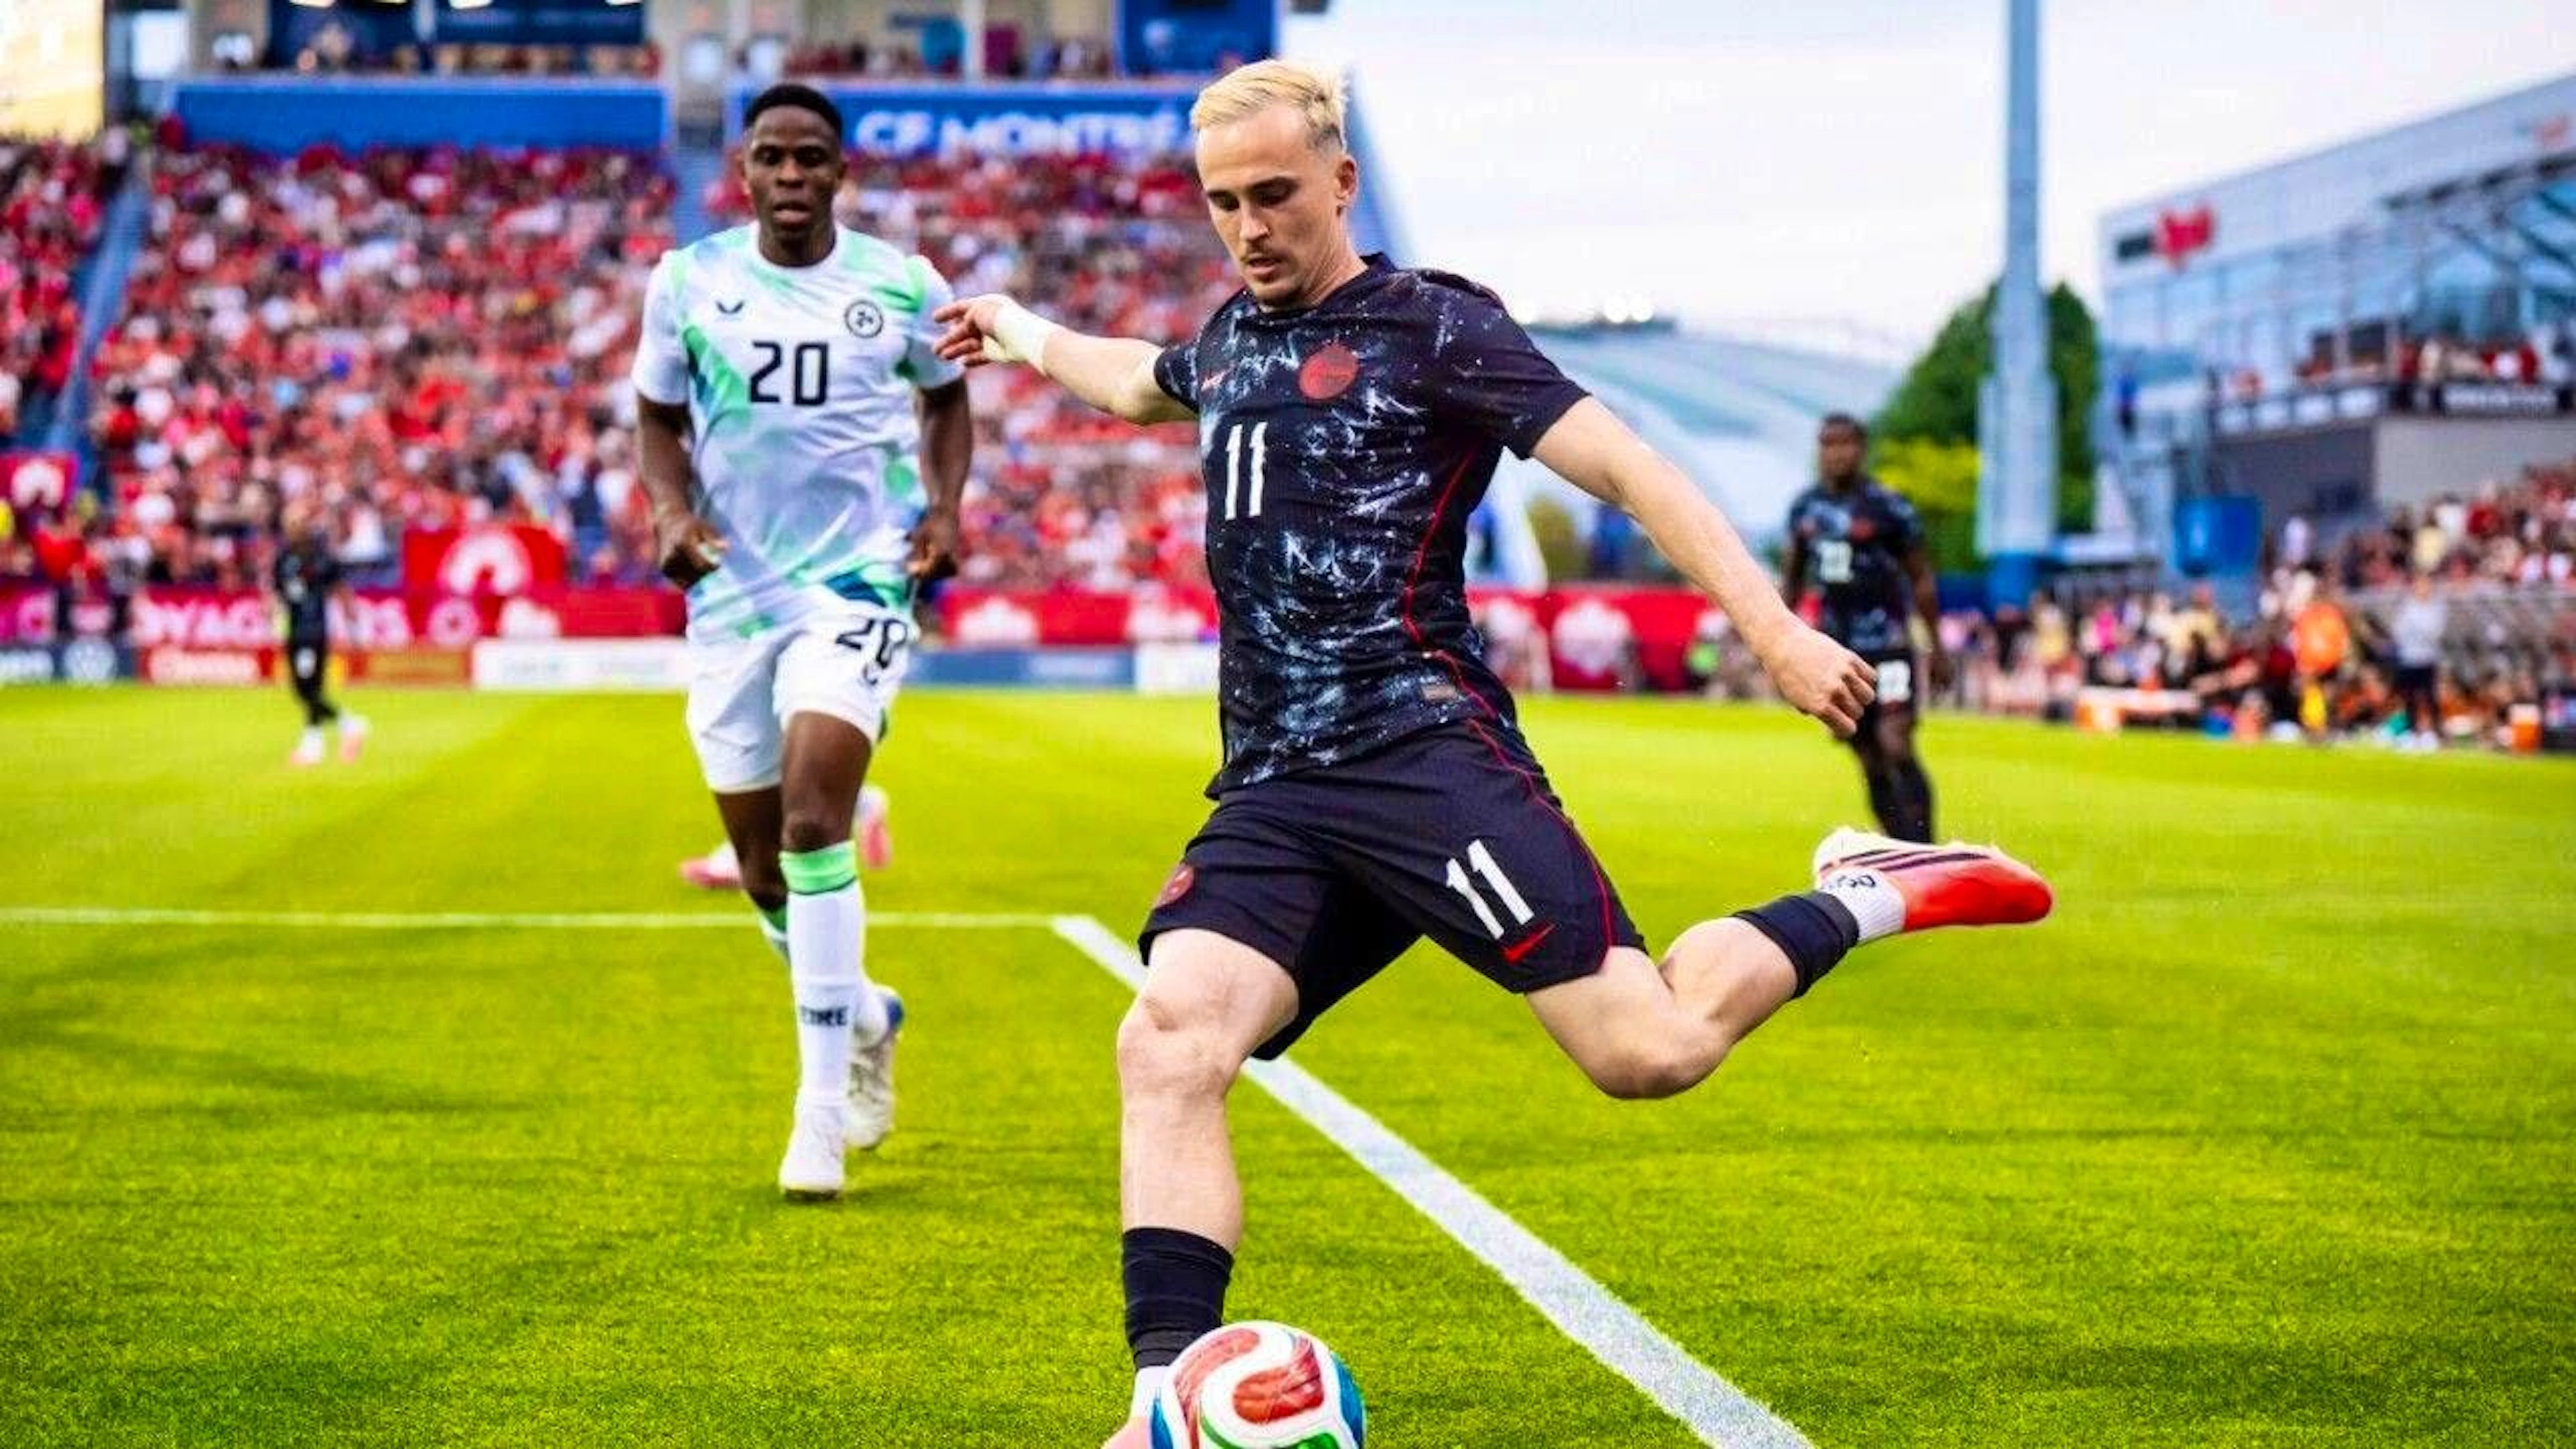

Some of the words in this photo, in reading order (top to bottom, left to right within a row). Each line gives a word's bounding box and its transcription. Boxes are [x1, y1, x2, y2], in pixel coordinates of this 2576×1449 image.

[855, 109, 935, 157] CF
[941, 102, 1183, 161] MONTRÉ
[749, 341, 829, 407] 20
[1224, 421, 1268, 521] 11
[835, 616, 908, 670] 20
[1446, 839, 1535, 940] 11
